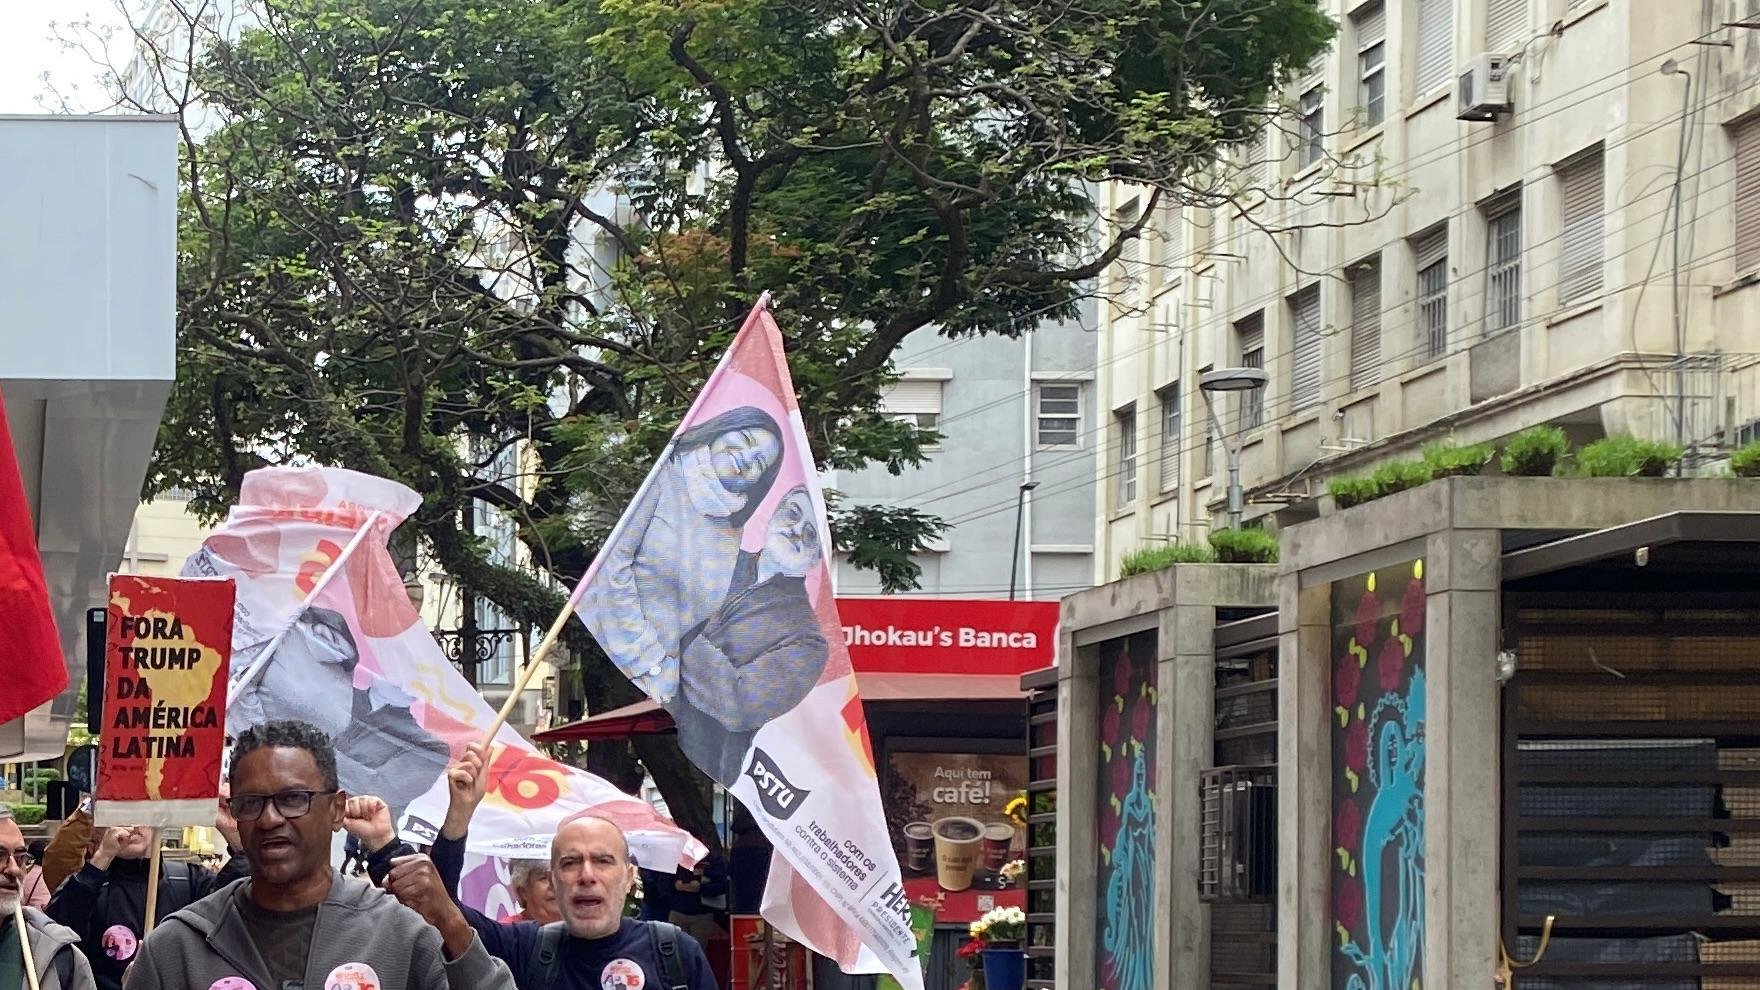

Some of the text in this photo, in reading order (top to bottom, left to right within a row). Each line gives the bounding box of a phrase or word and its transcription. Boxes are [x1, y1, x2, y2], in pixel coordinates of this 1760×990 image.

[120, 616, 184, 640] FORA
[958, 627, 1037, 648] Banca
[118, 646, 201, 670] TRUMP
[116, 676, 150, 700] DA
[112, 700, 218, 730] AMÉRICA
[111, 736, 196, 759] LATINA
[753, 760, 795, 809] PSTU
[934, 766, 992, 782] Aqui tem
[932, 780, 991, 804] café!
[795, 825, 822, 854] contra
[826, 858, 859, 891] sistema
[808, 820, 867, 881] trabalhadores
[843, 839, 865, 861] com
[862, 858, 877, 872] os
